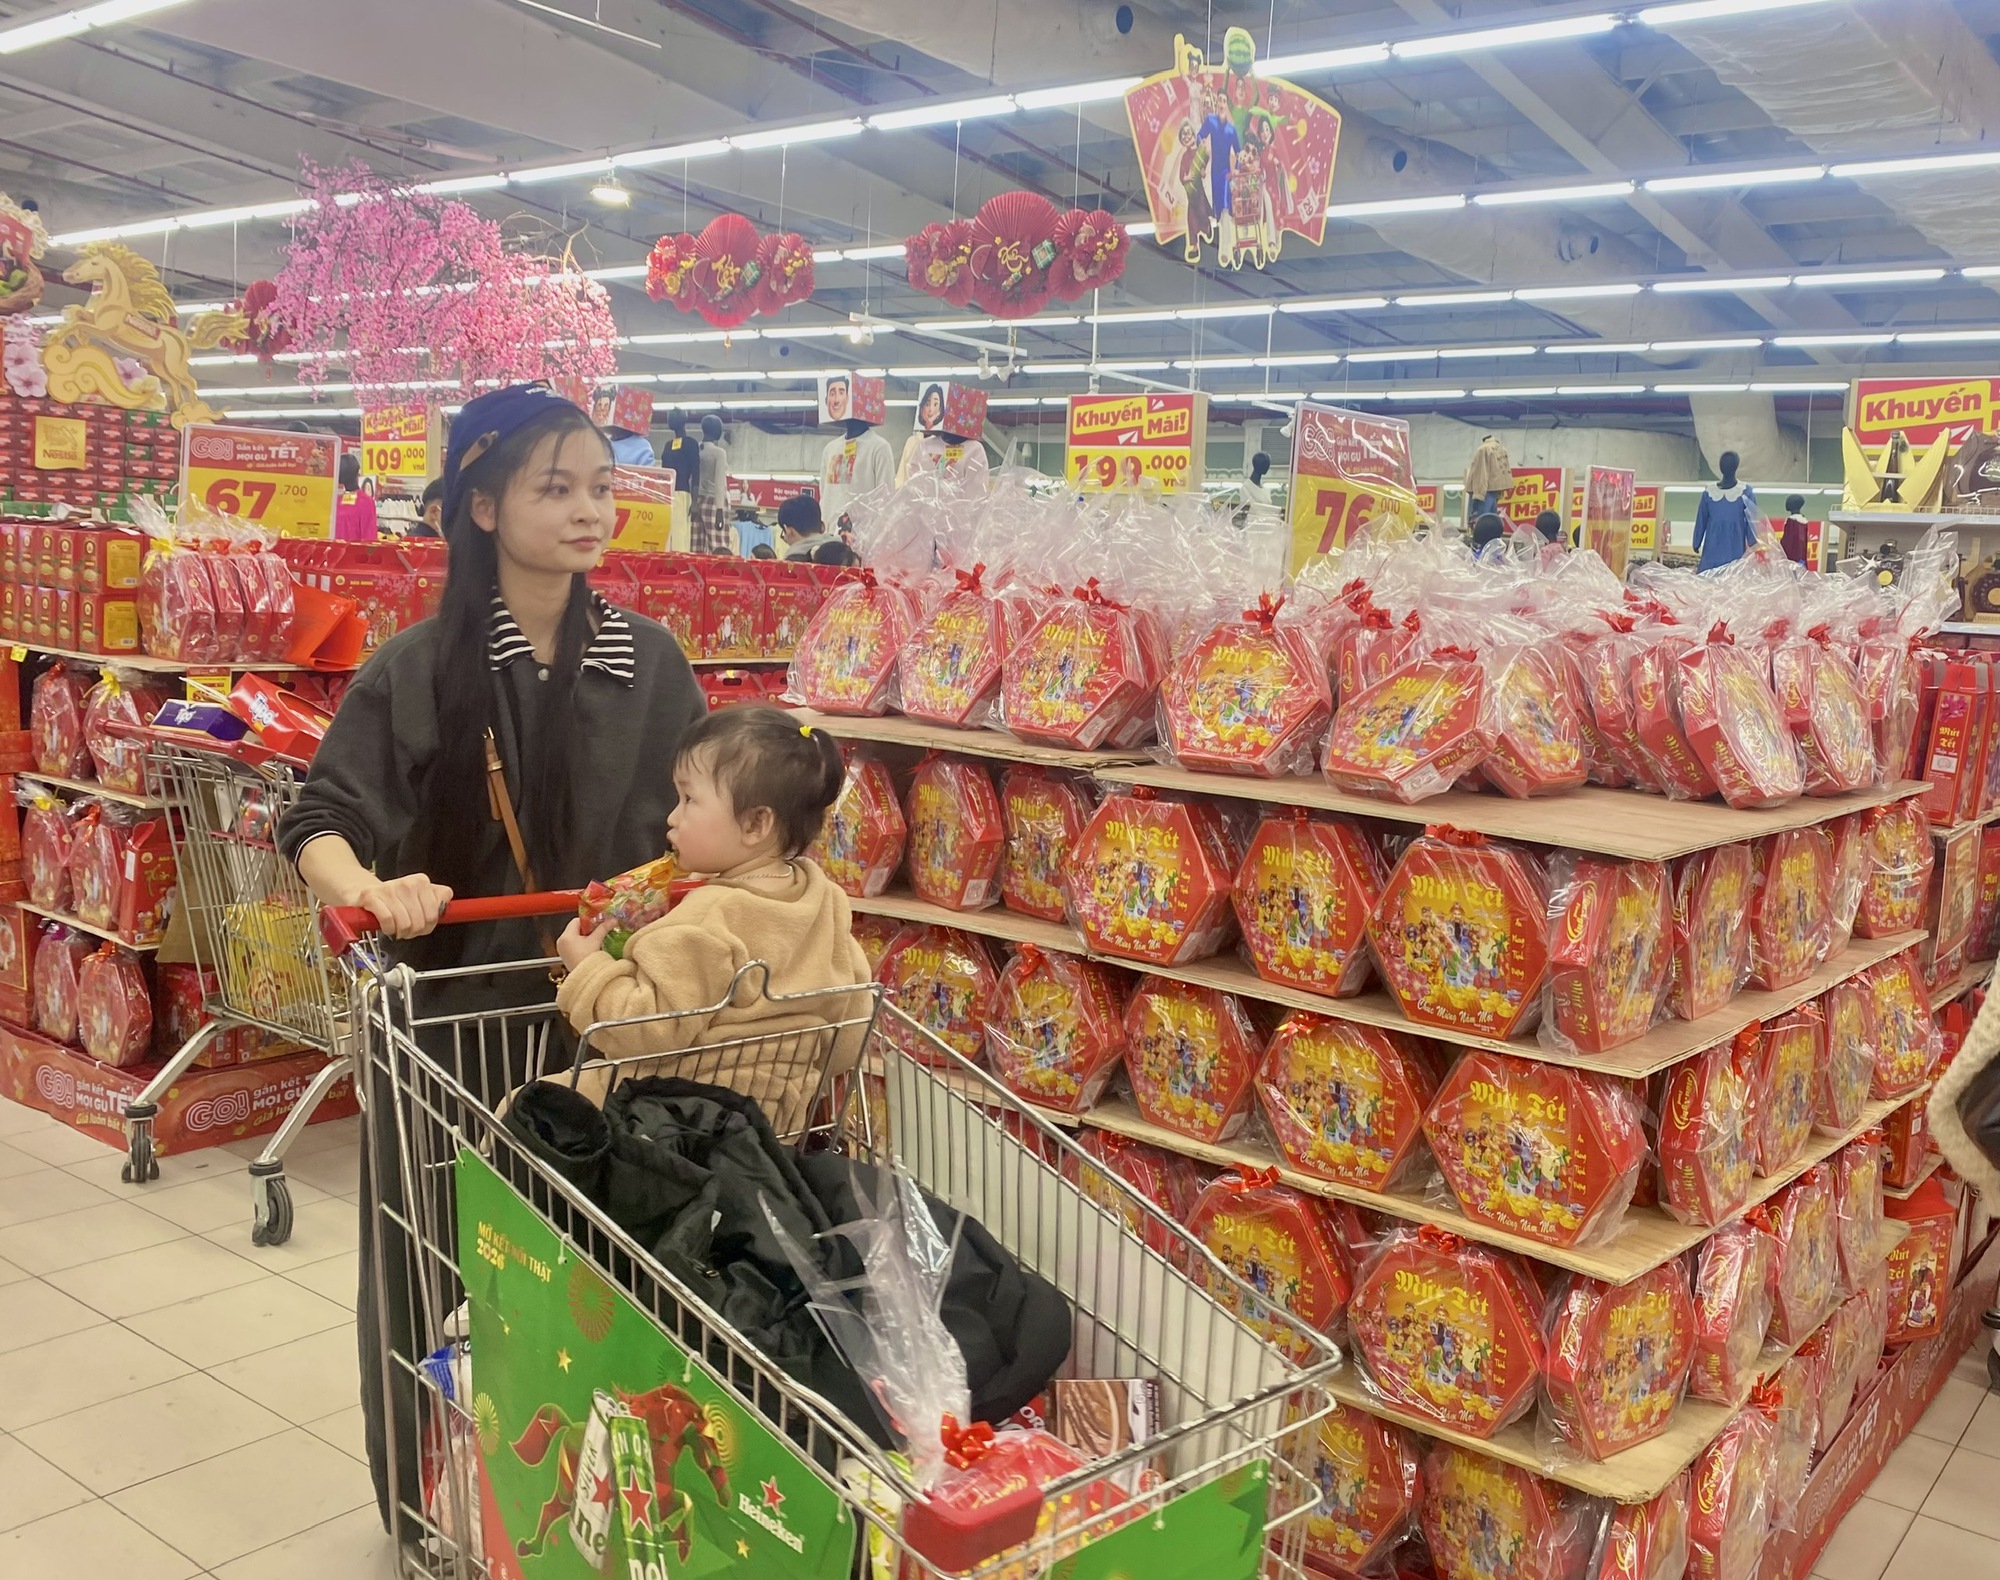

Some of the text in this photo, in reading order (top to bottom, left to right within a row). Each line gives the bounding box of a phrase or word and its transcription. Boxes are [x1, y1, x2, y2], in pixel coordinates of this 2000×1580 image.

[1076, 402, 1143, 428] Khuyến
[1866, 387, 1982, 423] Khuyến
[1147, 412, 1187, 436] Mãi!
[191, 436, 234, 461] GO!
[255, 453, 268, 462] GU
[268, 441, 300, 460] TẾT
[366, 447, 425, 471] 109 .000
[1146, 454, 1188, 470] .000
[205, 478, 308, 520] 67 .700
[1513, 492, 1557, 518] Mãi!
[633, 510, 654, 521] .700
[1315, 489, 1376, 554] 76
[1149, 826, 1180, 849] Tết
[36, 1064, 75, 1109] GO!
[91, 1082, 104, 1096] kết
[252, 1087, 306, 1111] MỌI GU
[253, 1082, 278, 1100] gắn
[280, 1076, 301, 1090] kết
[76, 1092, 109, 1112] MỌI GU
[186, 1090, 251, 1132] GO!
[1527, 1092, 1567, 1123] Tết
[253, 1110, 274, 1127] Giá
[476, 1236, 506, 1271] 2026
[1262, 1229, 1297, 1254] Tết
[528, 1255, 553, 1283] THẬT
[1450, 1286, 1489, 1317] Tết
[578, 1438, 599, 1501] SILVER
[738, 1491, 804, 1555] Heineken
